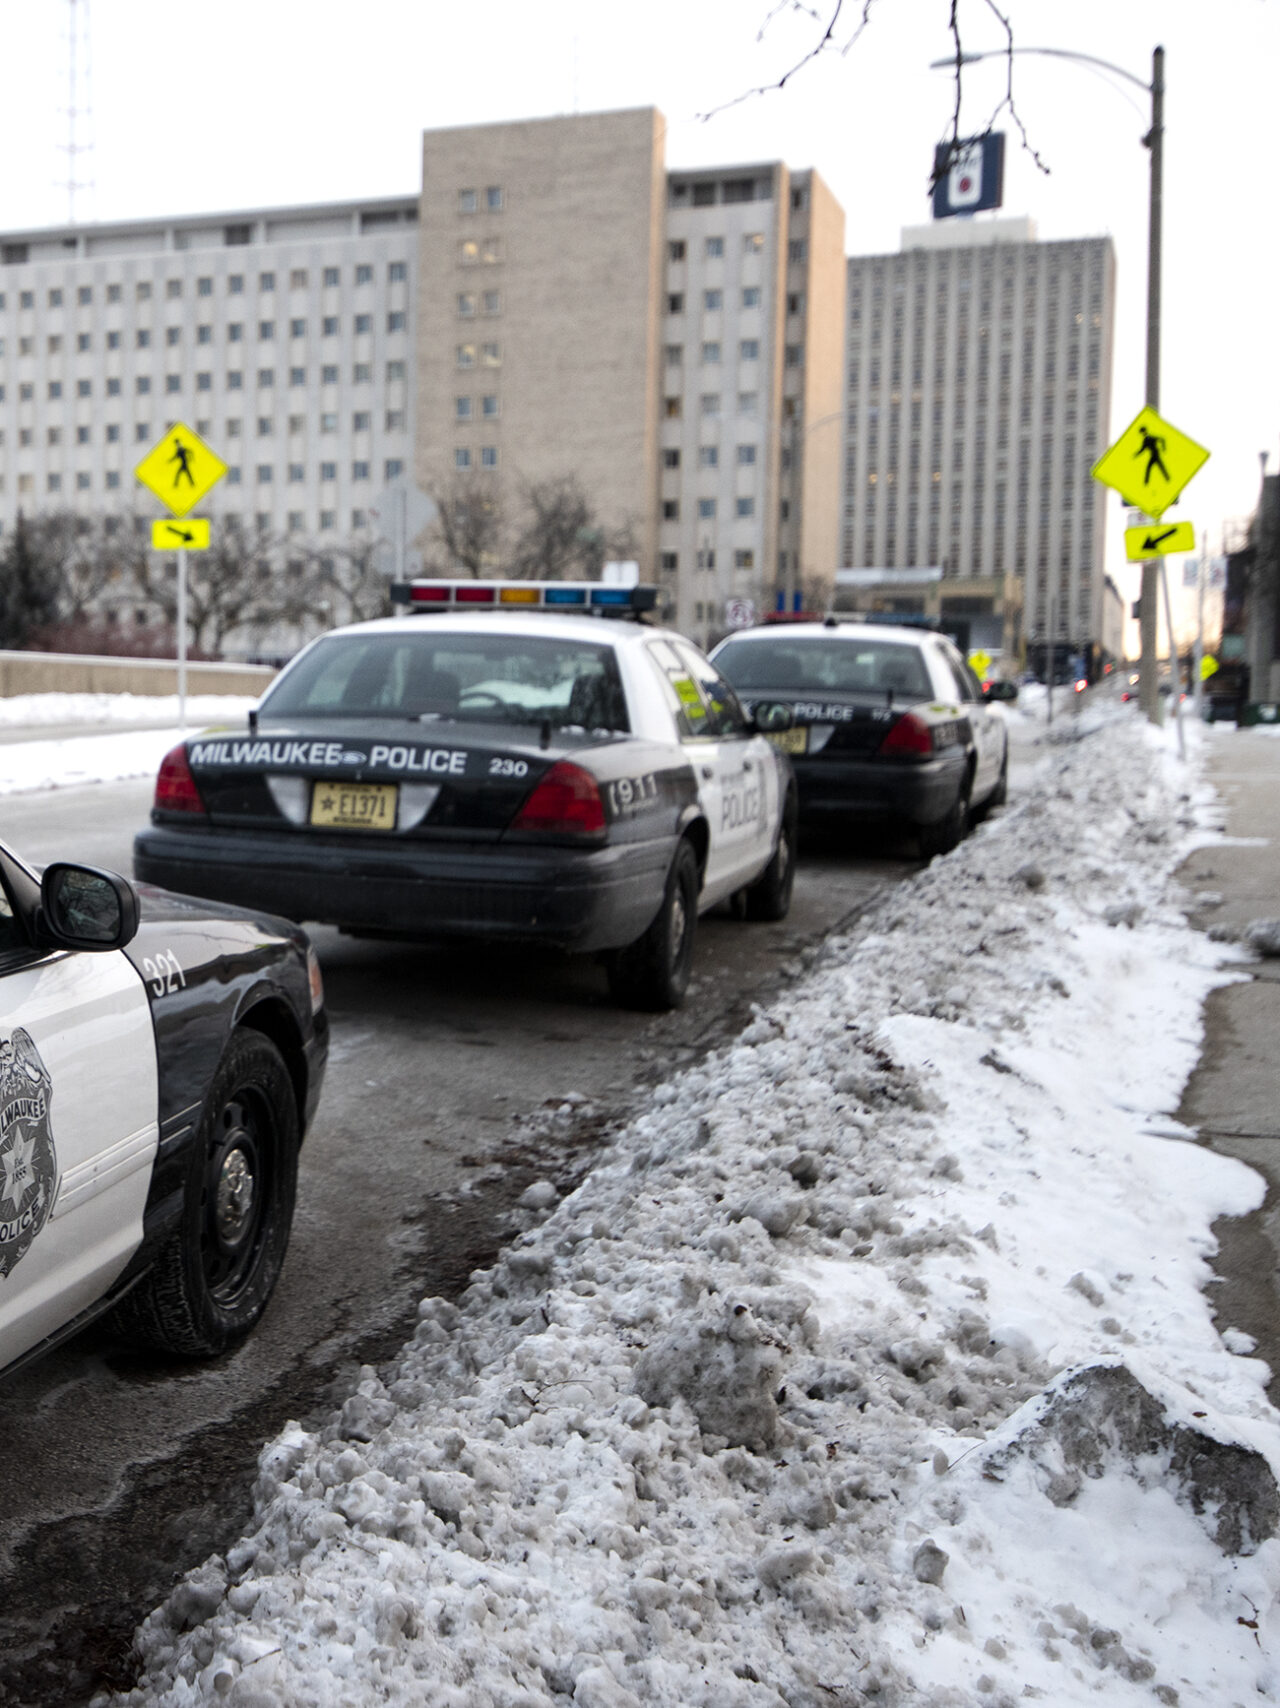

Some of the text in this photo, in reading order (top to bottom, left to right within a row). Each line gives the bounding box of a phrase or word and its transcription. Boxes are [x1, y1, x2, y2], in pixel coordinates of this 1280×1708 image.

[794, 702, 853, 721] POLICE
[189, 742, 343, 765] MILWAUKEE
[370, 745, 467, 774] POLICE
[488, 757, 529, 777] 230
[339, 794, 385, 817] E1371
[143, 948, 187, 997] 321
